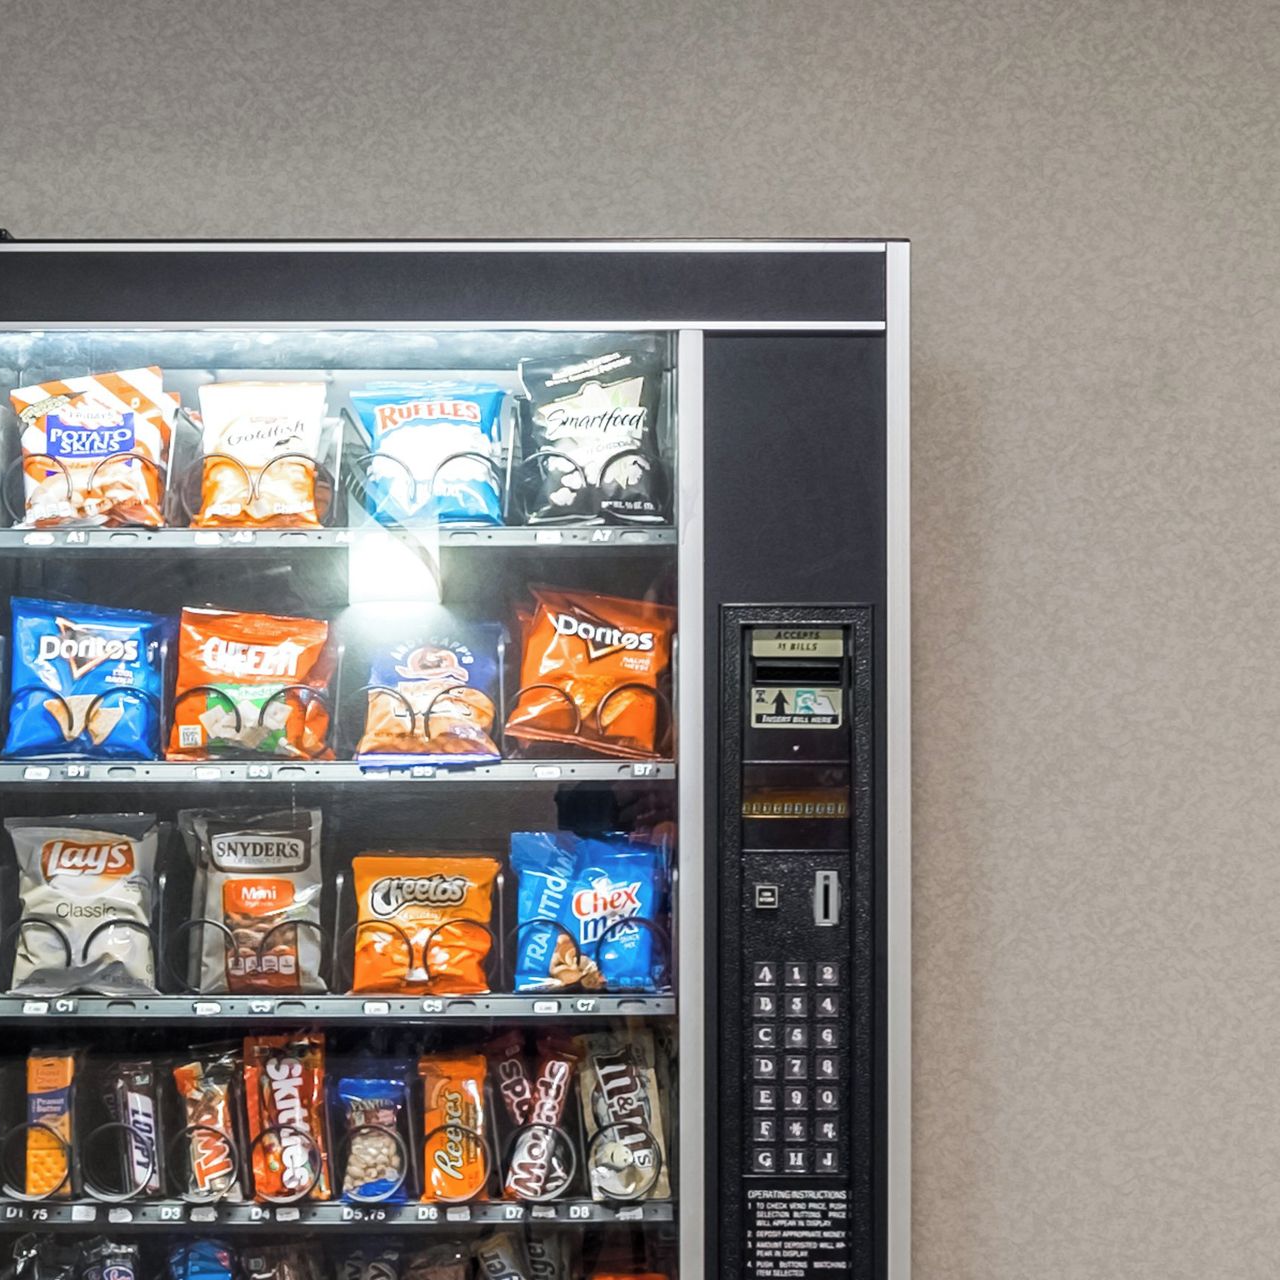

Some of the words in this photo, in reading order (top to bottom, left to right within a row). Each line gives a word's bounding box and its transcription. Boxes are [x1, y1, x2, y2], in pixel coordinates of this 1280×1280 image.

[377, 400, 480, 431] RUFFLES
[547, 406, 645, 436] Smartfood
[50, 428, 132, 443] POTATO
[59, 438, 120, 454] SKINS
[592, 530, 611, 542] A7
[557, 613, 654, 650] Doritos
[775, 631, 821, 640] ACCEPTS
[40, 635, 138, 661] Doritos
[790, 643, 818, 651] BILLS
[216, 841, 300, 858] SNYDER'S
[241, 886, 276, 900] Mini
[370, 875, 467, 918] Cheetos
[574, 880, 640, 917] Chex
[56, 902, 117, 918] Classic
[758, 966, 773, 982] A
[792, 967, 801, 981] 1
[822, 966, 834, 980] 2
[577, 999, 595, 1011] C7
[759, 997, 772, 1012] B
[791, 997, 802, 1011] 3
[822, 997, 833, 1011] 4
[758, 1028, 772, 1041] C
[791, 1028, 802, 1041] 5
[822, 1029, 833, 1042] 6
[759, 1059, 773, 1072] D
[791, 1059, 802, 1073] 7
[759, 1090, 772, 1104] E
[791, 1090, 802, 1104] 9
[822, 1090, 833, 1104] 0
[266, 1057, 311, 1189] Skittles
[758, 1152, 772, 1167] G
[789, 1152, 803, 1166] H
[822, 1152, 832, 1166] J
[161, 1207, 181, 1219] D3
[418, 1208, 437, 1219] D6
[506, 1208, 523, 1219] D7
[570, 1207, 589, 1218] D8
